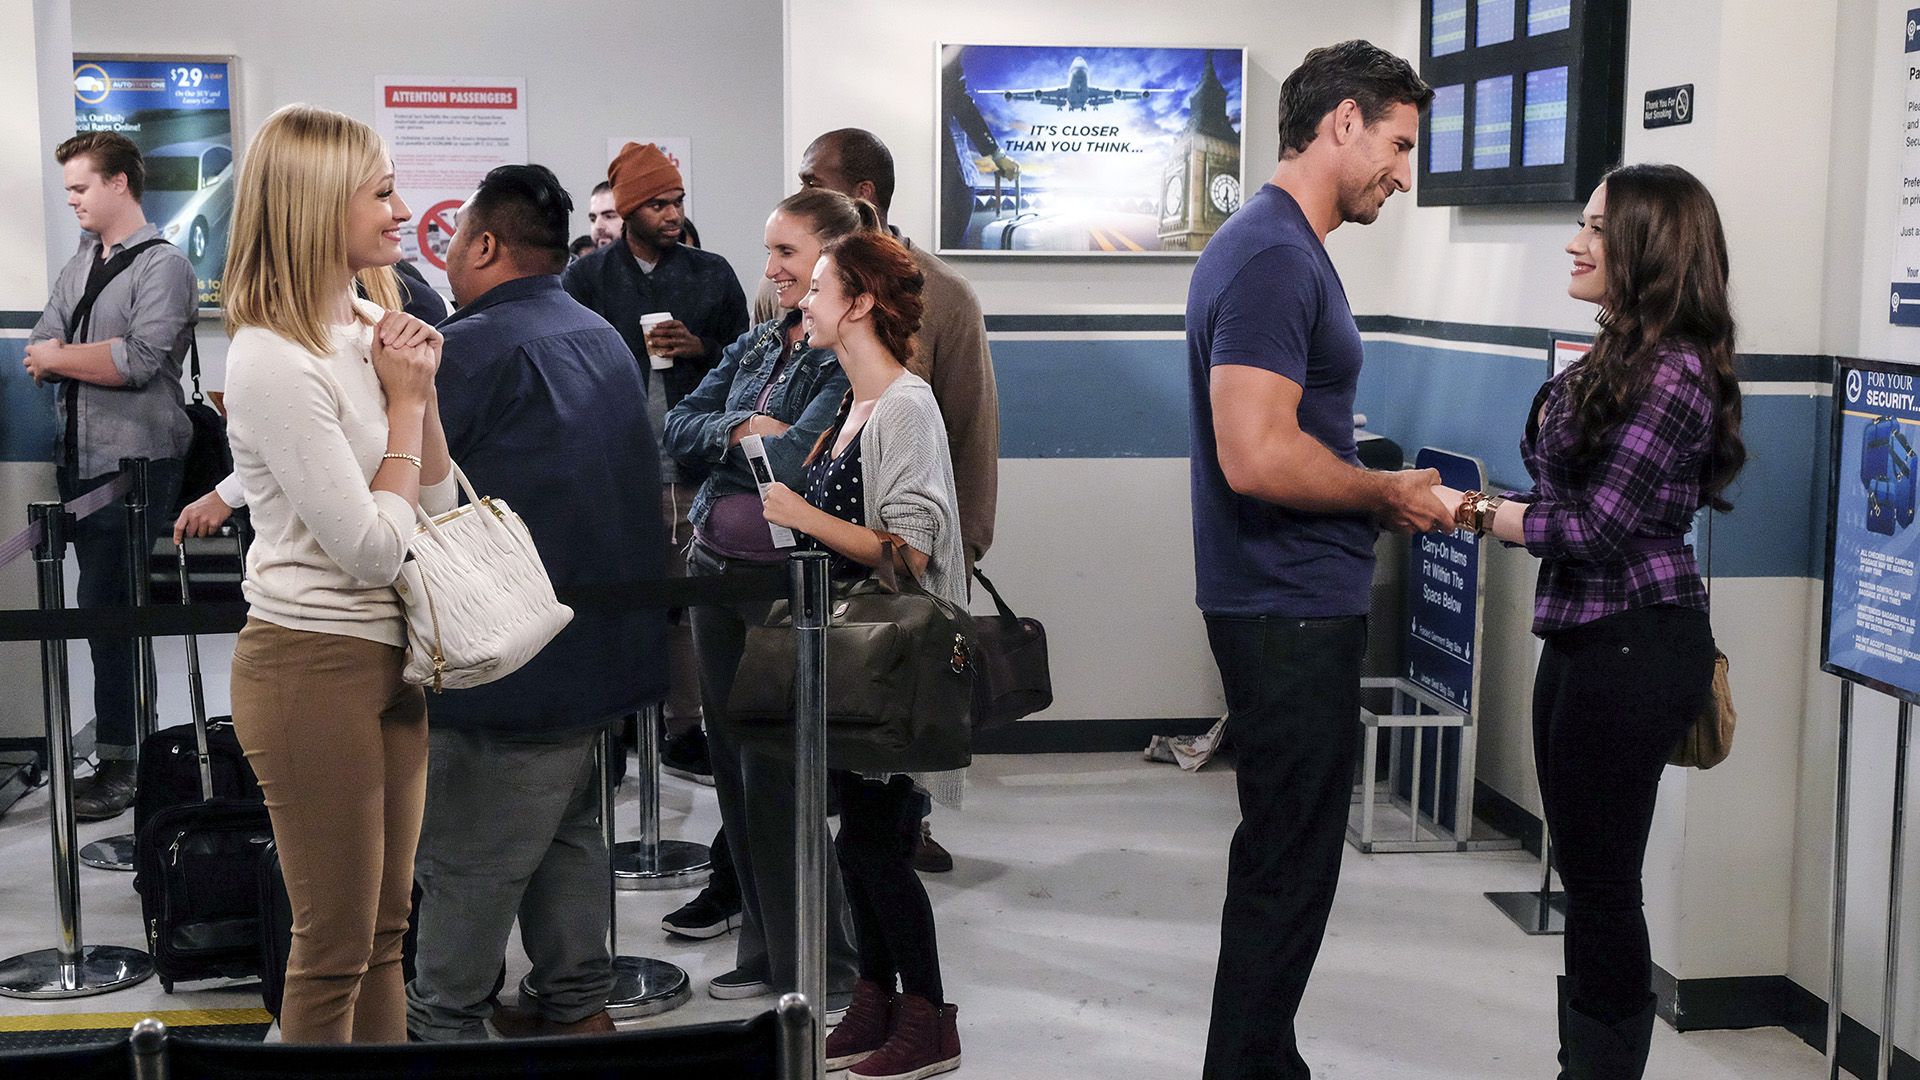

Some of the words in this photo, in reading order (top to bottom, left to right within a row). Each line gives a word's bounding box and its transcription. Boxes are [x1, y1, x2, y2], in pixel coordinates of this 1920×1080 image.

[392, 91, 447, 103] ATTENTION
[449, 91, 513, 104] PASSENGERS
[1668, 97, 1676, 107] For
[89, 113, 104, 122] Our
[105, 113, 126, 124] Daily
[1653, 109, 1672, 120] Smoking
[1907, 118, 1920, 130] and
[1030, 125, 1058, 136] IT'S
[1062, 125, 1120, 137] CLOSER
[1005, 140, 1047, 152] THAN
[1051, 141, 1082, 152] YOU
[1086, 141, 1144, 153] THINK...
[1900, 226, 1914, 237] Just
[1906, 266, 1919, 279] Your
[1867, 371, 1885, 388] FOR
[1887, 373, 1913, 391] YOUR
[1421, 535, 1449, 560] Carry-On
[1450, 545, 1468, 568] Items
[1423, 559, 1431, 577] Fit
[1432, 562, 1451, 585] Within
[1452, 570, 1464, 590] The
[1423, 583, 1442, 605] Space
[1443, 591, 1463, 614] Below
